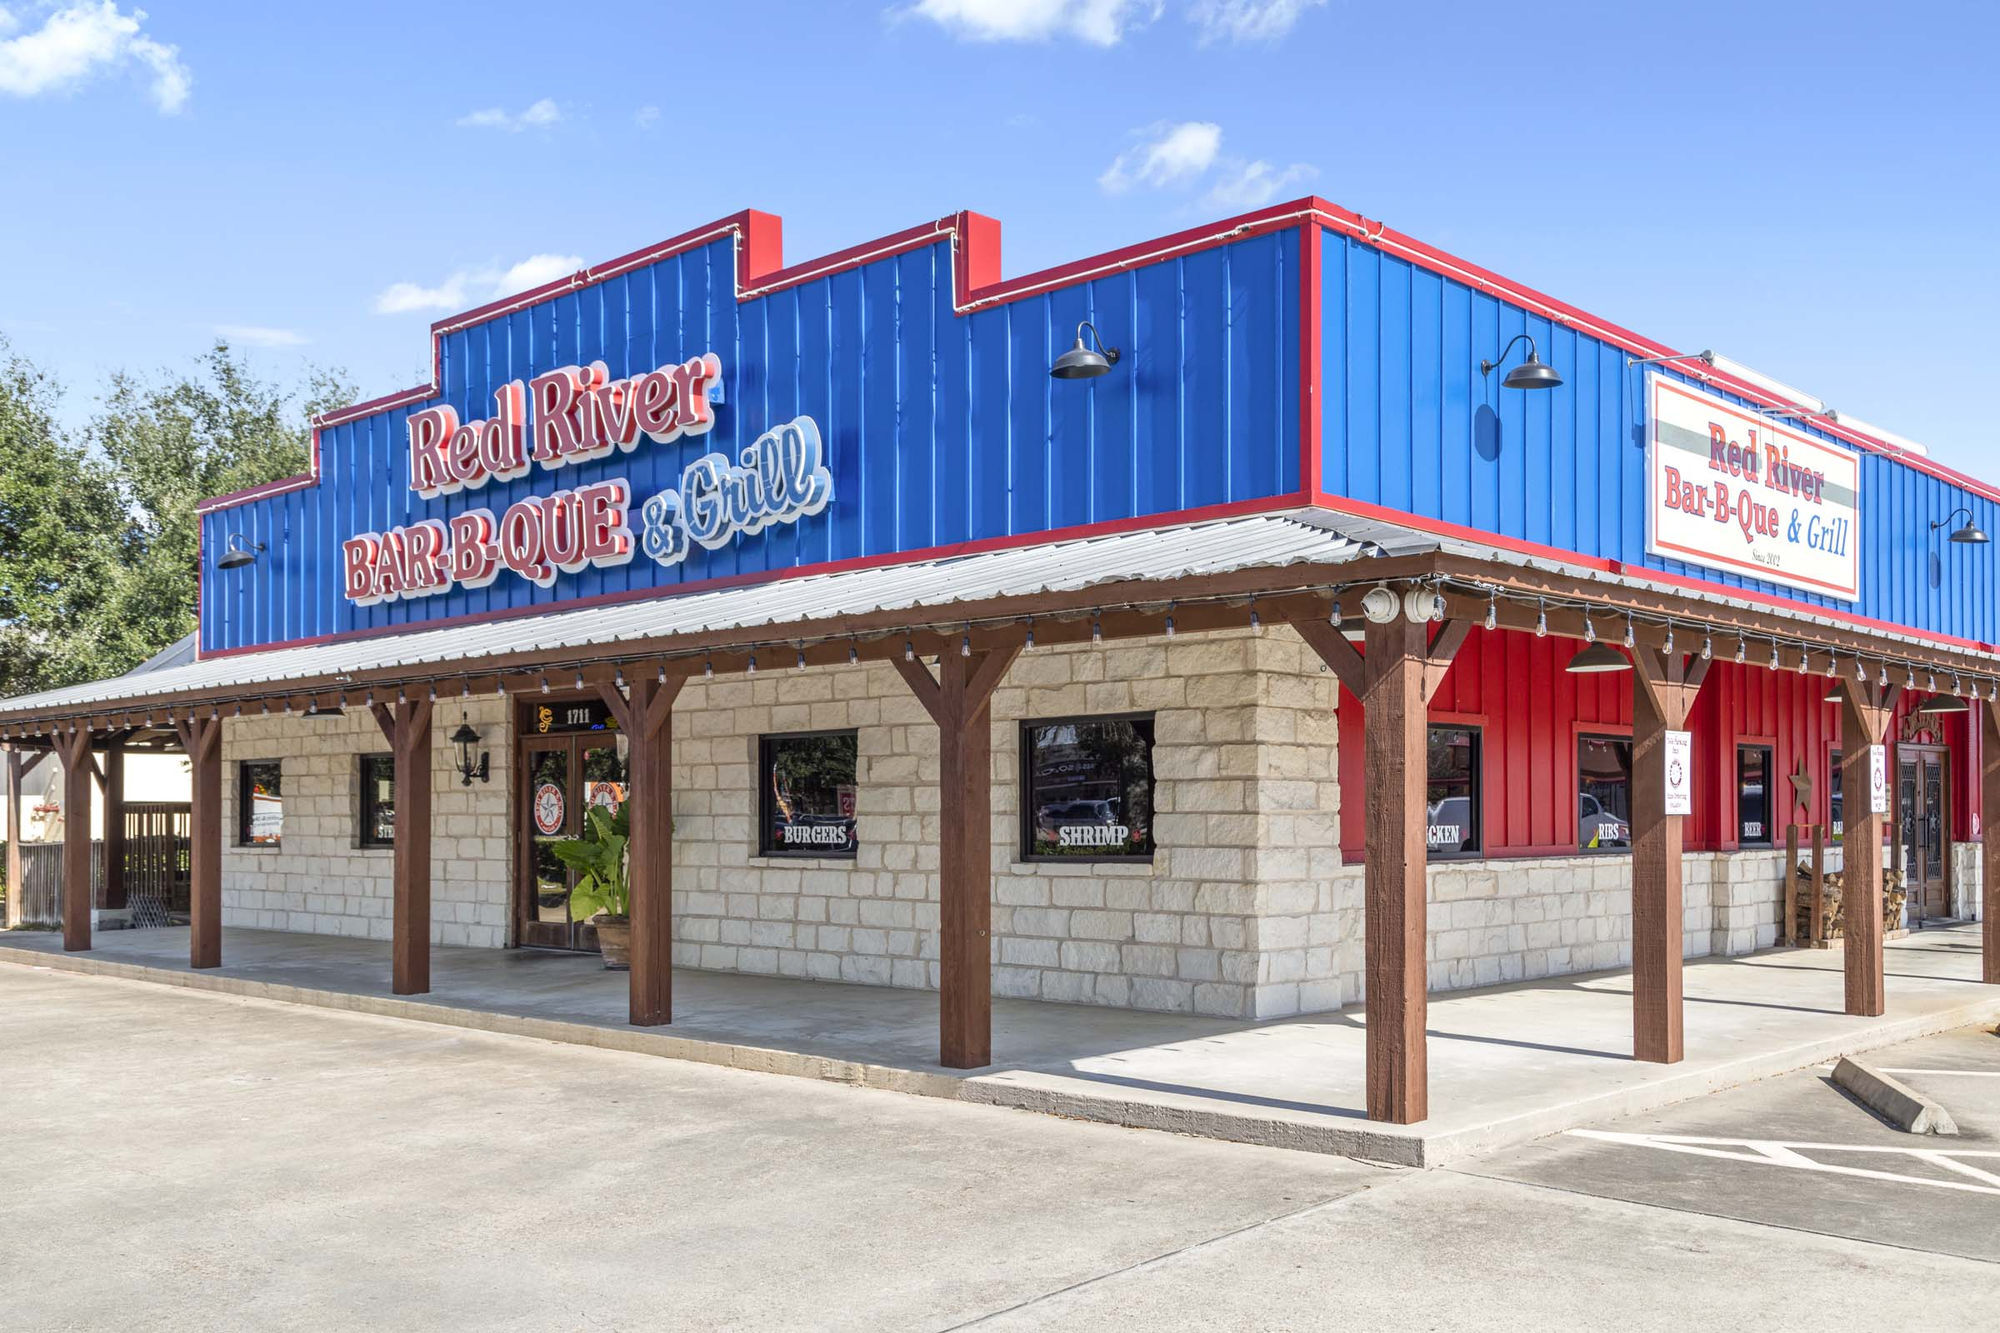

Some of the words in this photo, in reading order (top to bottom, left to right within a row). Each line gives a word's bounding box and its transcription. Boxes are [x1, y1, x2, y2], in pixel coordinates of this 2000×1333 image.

[408, 378, 523, 488] Red
[527, 353, 720, 462] River
[1708, 422, 1760, 484] Red
[1765, 442, 1824, 505] River
[642, 490, 686, 557] &
[683, 418, 823, 532] Grill
[1664, 465, 1779, 544] Bar-B-Que
[1787, 508, 1802, 544] &
[1807, 514, 1848, 557] Grill
[567, 709, 590, 725] 1711
[784, 826, 847, 844] BURGERS
[1059, 826, 1130, 846] SHRIMP
[1598, 823, 1620, 840] RIBS
[1744, 821, 1762, 837] BEER
